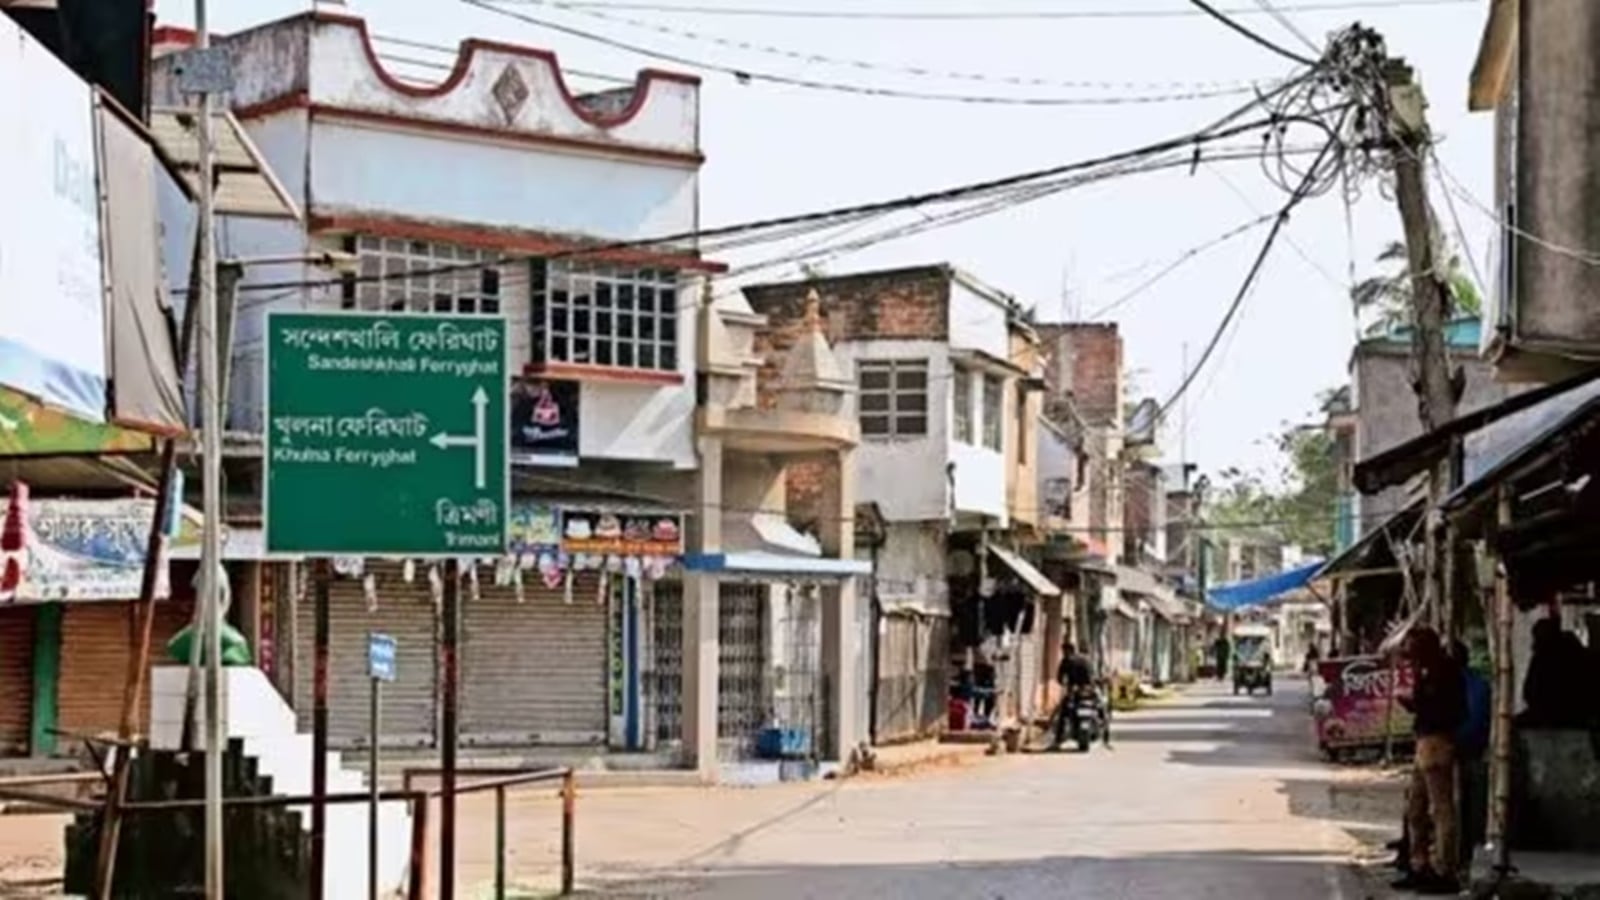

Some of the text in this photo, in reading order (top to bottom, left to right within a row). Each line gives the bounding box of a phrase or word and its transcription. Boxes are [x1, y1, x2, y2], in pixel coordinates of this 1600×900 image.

[281, 320, 500, 352] সন্দেশখালি ফেরিঘাট
[307, 353, 499, 378] Sandeshkhali Ferryghat
[273, 407, 429, 446] খুলনা ফেরিঘাট
[273, 448, 417, 468] Khulna Ferryghat
[445, 531, 500, 547] Trimani
